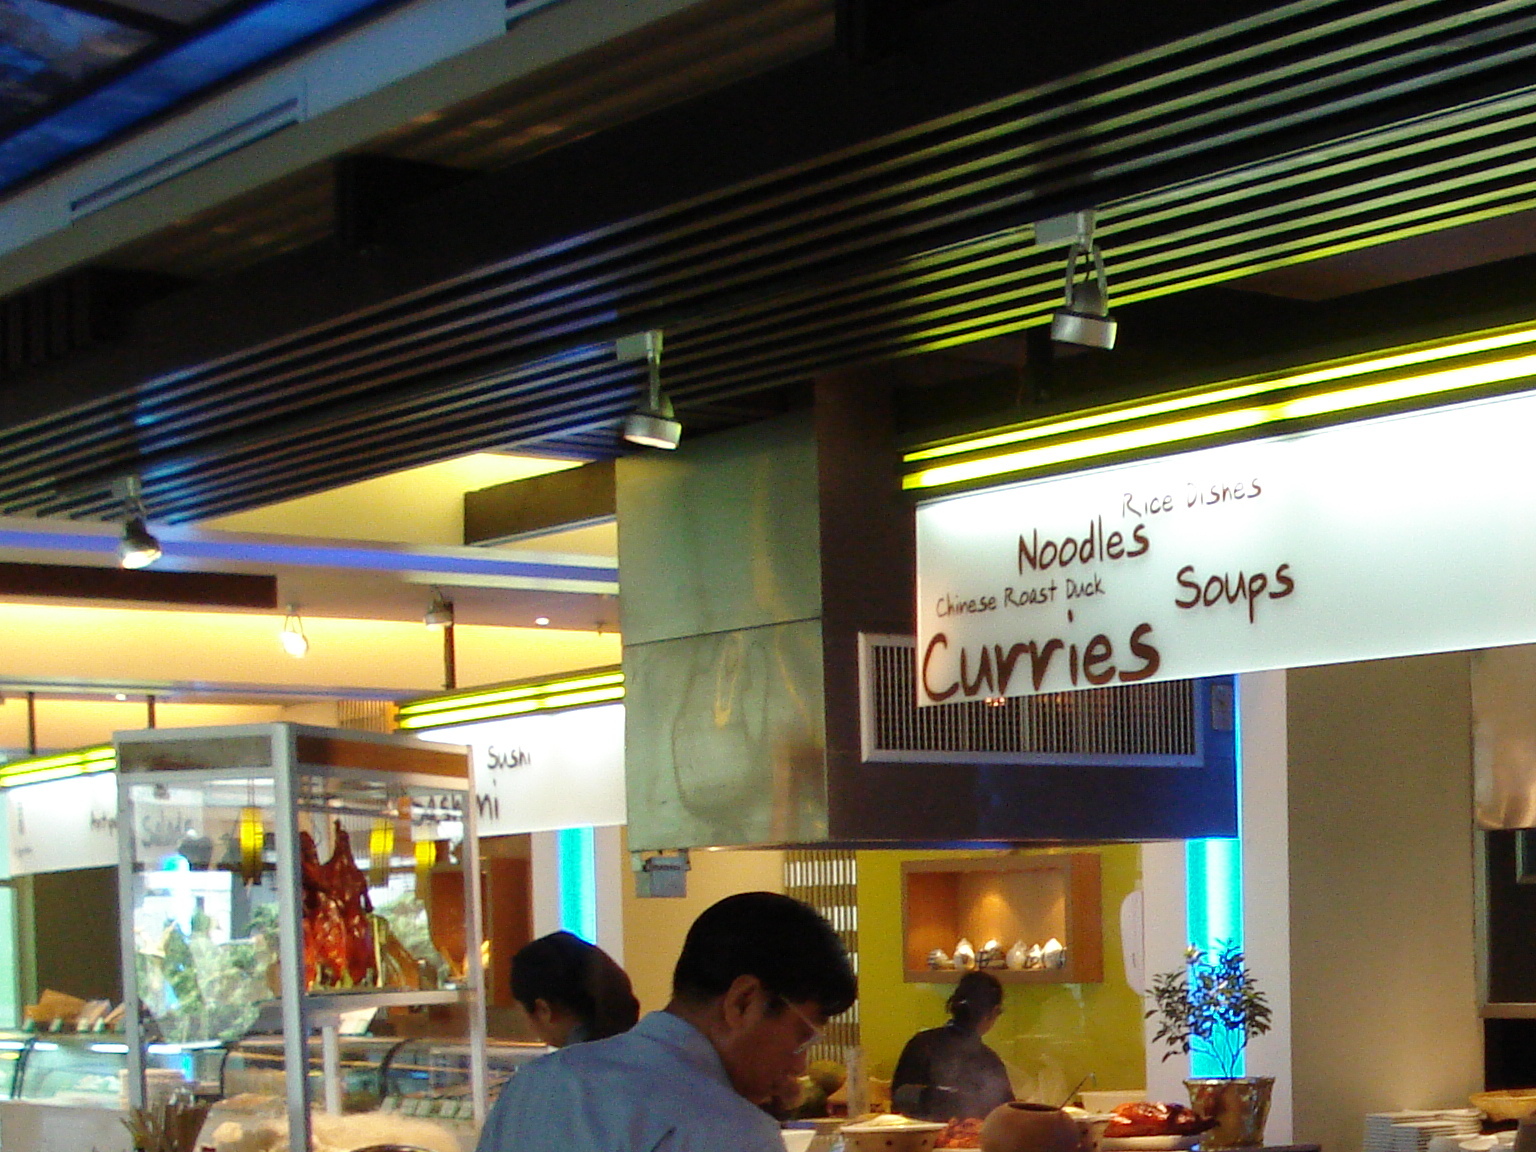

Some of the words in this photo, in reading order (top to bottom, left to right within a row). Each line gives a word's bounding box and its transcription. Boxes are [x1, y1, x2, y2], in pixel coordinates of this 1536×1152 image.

[1122, 492, 1173, 518] Rice
[1187, 477, 1262, 508] Dishes
[1018, 514, 1150, 575] Noodles
[936, 591, 996, 618] Chinese
[1004, 580, 1057, 607] Roast
[1065, 573, 1106, 600] Duck
[1174, 563, 1295, 624] Soups
[921, 608, 1161, 702] Curries
[487, 745, 531, 769] Sushi
